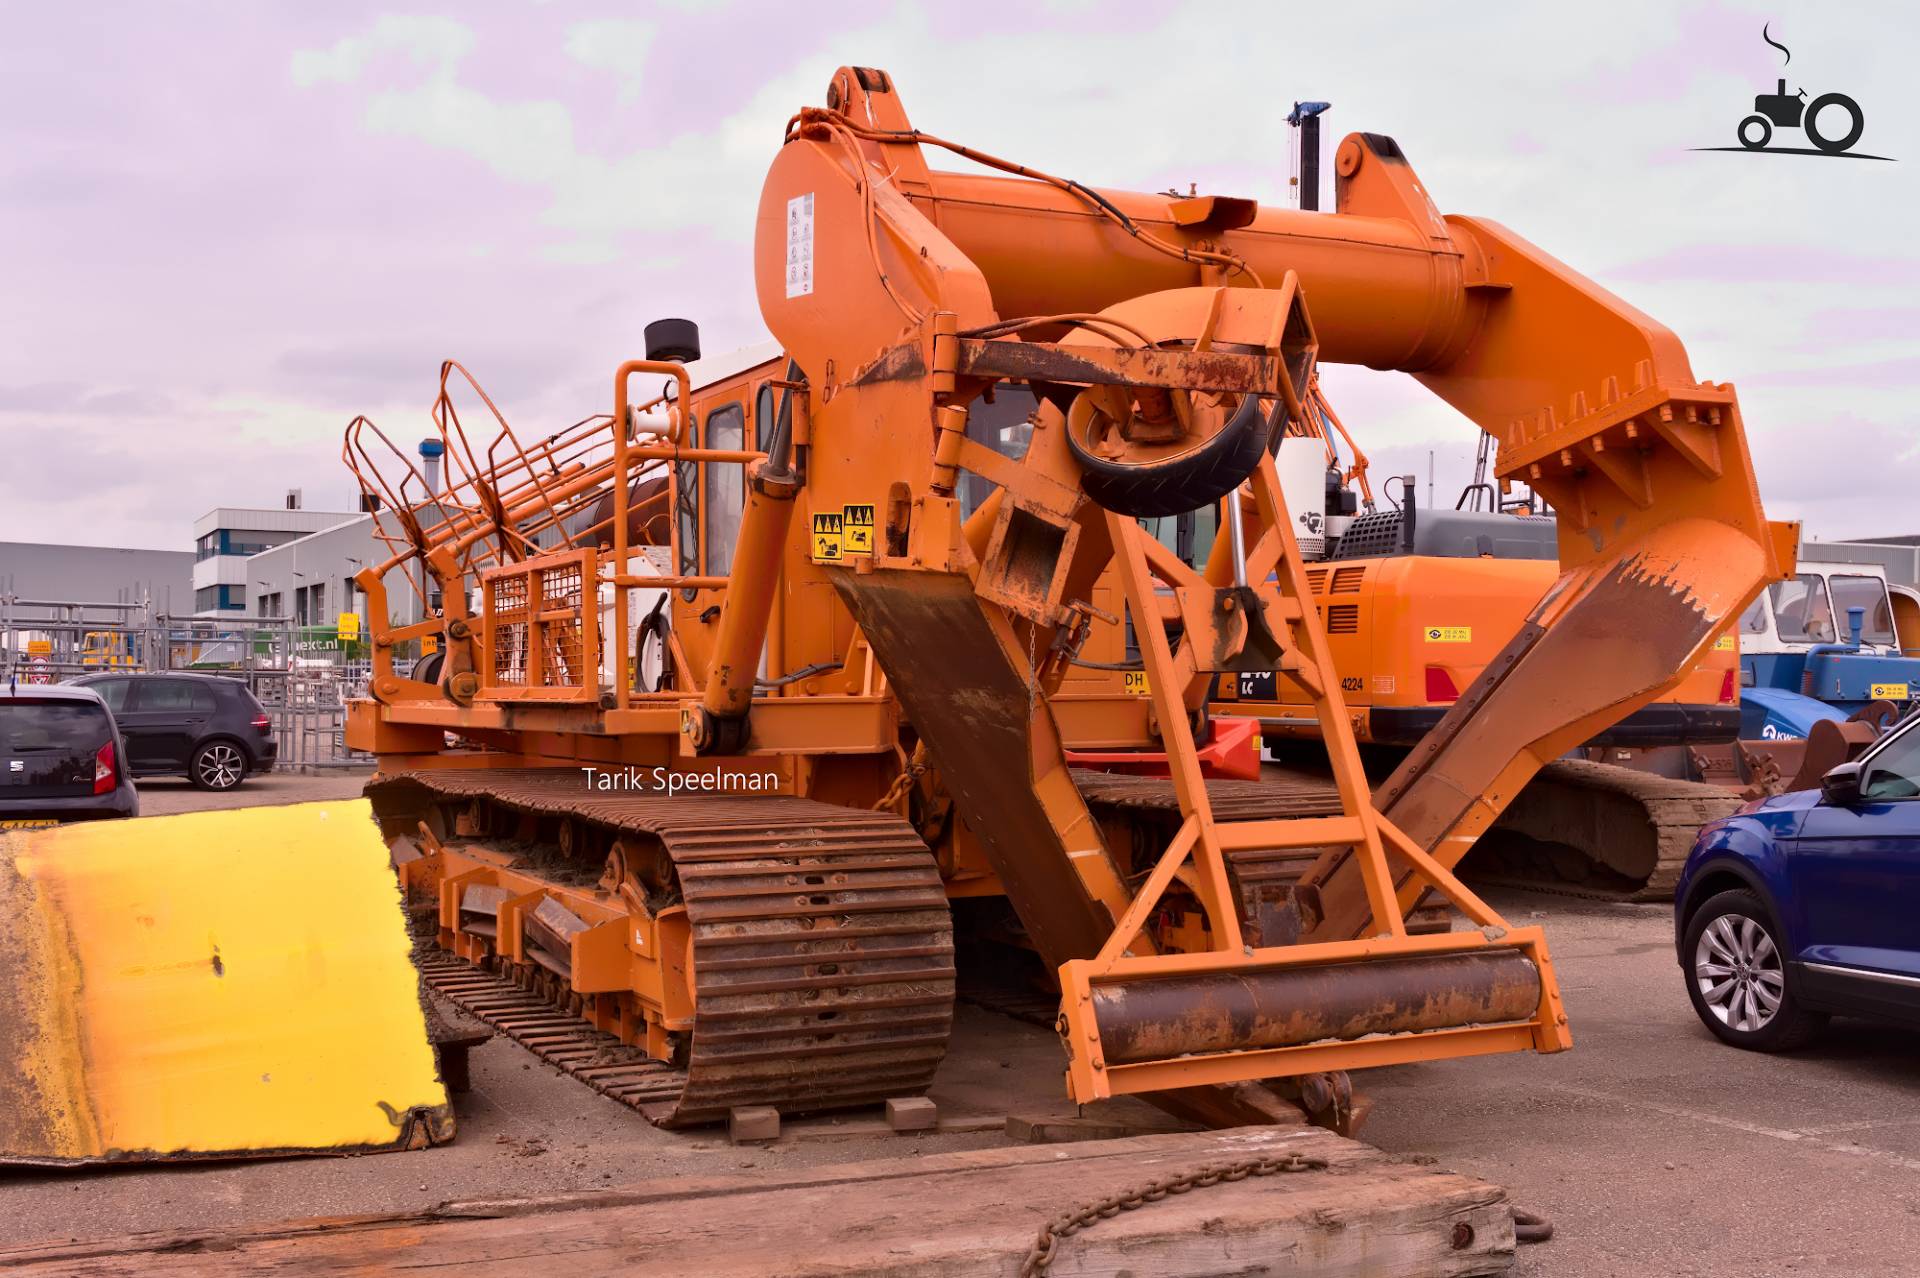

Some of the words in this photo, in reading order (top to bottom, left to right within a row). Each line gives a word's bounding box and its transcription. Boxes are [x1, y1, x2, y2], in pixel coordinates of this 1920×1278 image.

[1241, 681, 1253, 695] LC
[1341, 677, 1363, 691] 4224
[1776, 731, 1798, 740] KW
